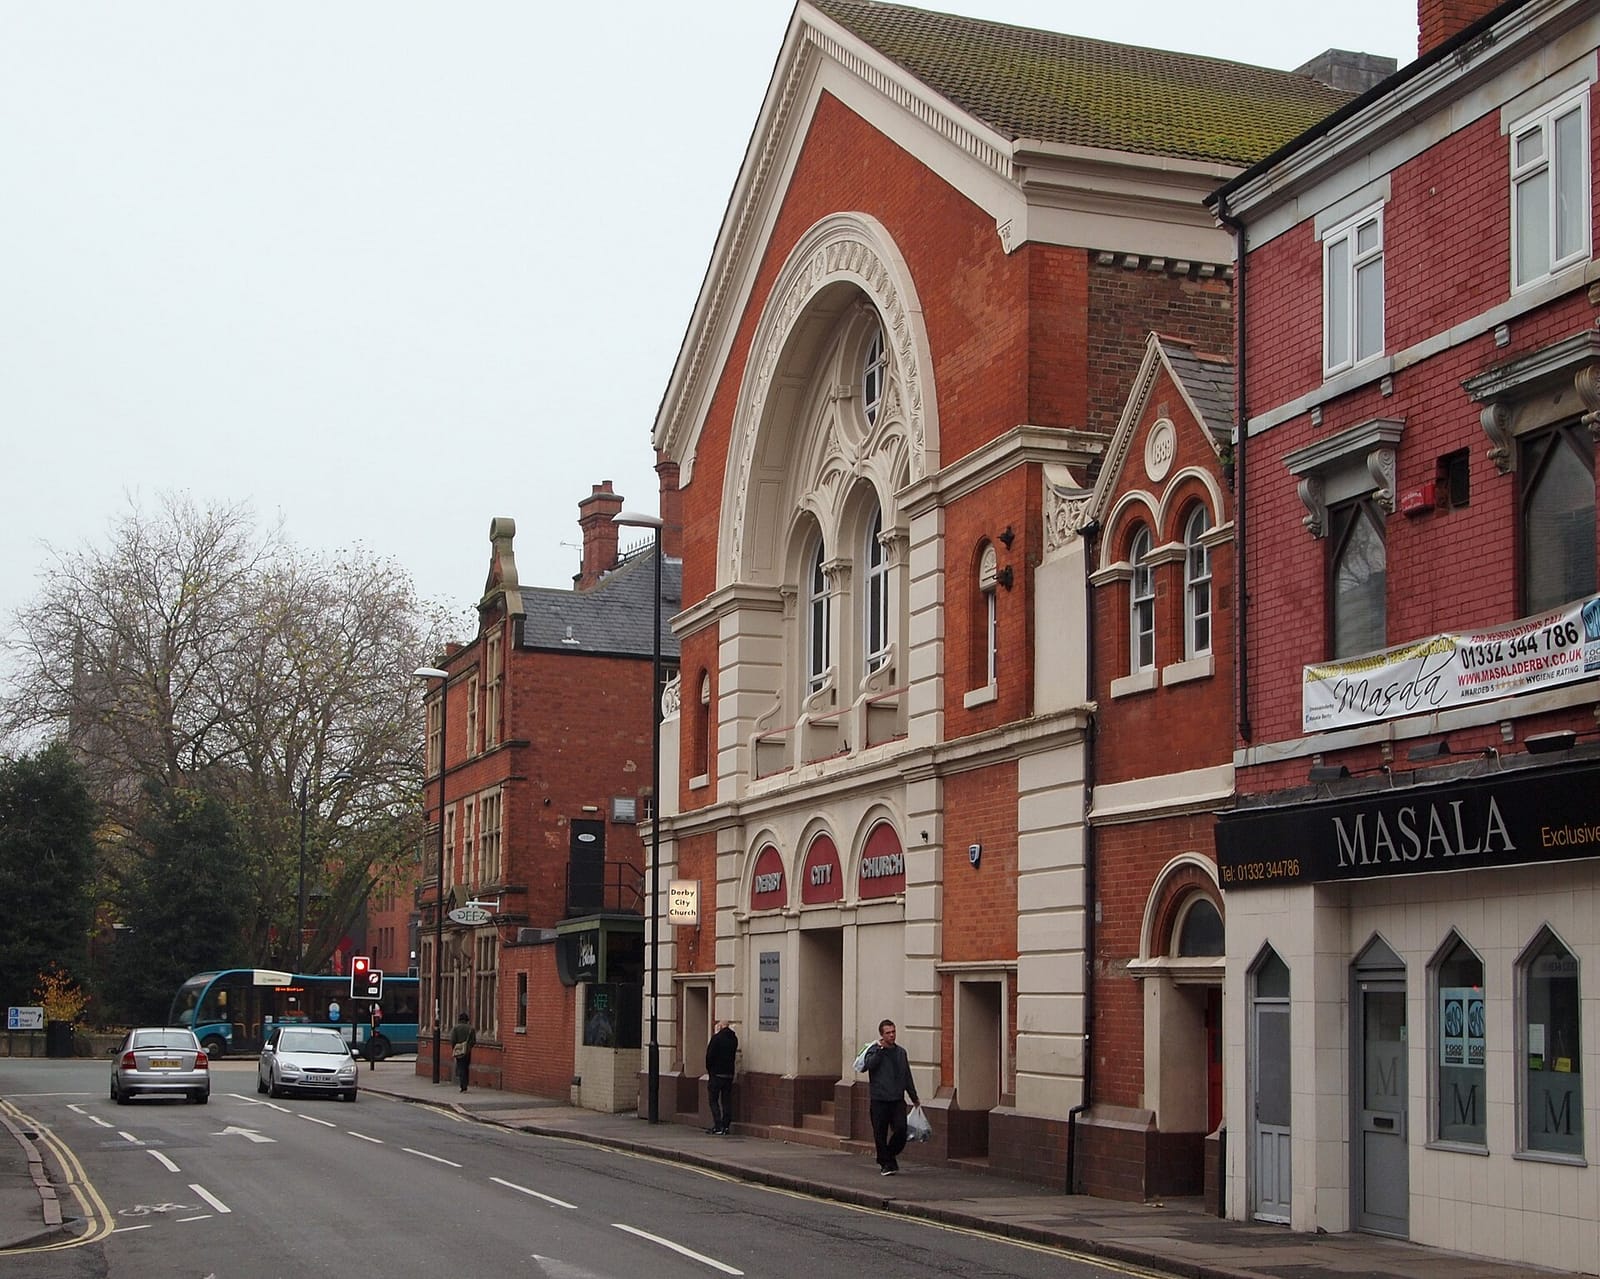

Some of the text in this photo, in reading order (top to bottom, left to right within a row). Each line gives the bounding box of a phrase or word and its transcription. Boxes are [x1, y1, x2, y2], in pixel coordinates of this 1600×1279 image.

[1461, 622, 1579, 669] 01332 344 786
[1487, 621, 1542, 641] RESERVATIONS
[1306, 636, 1460, 683] AWARD WINNING RESTAURANT
[1334, 644, 1457, 716] Masala
[1458, 648, 1582, 687] WWW.MASALADERBY.CO.UK
[1461, 686, 1489, 697] AWARDED
[1526, 671, 1554, 684] HYGIENE
[1555, 665, 1579, 678] RATING
[1331, 795, 1517, 868] MASALA
[755, 853, 904, 894] DERBY CITY CHURCH
[1221, 859, 1300, 882] Tel: 01332 344786
[671, 889, 695, 897] Derby
[675, 899, 690, 907] City
[1376, 1056, 1399, 1097] M
[1450, 1083, 1479, 1126] M
[1542, 1089, 1574, 1136] M
